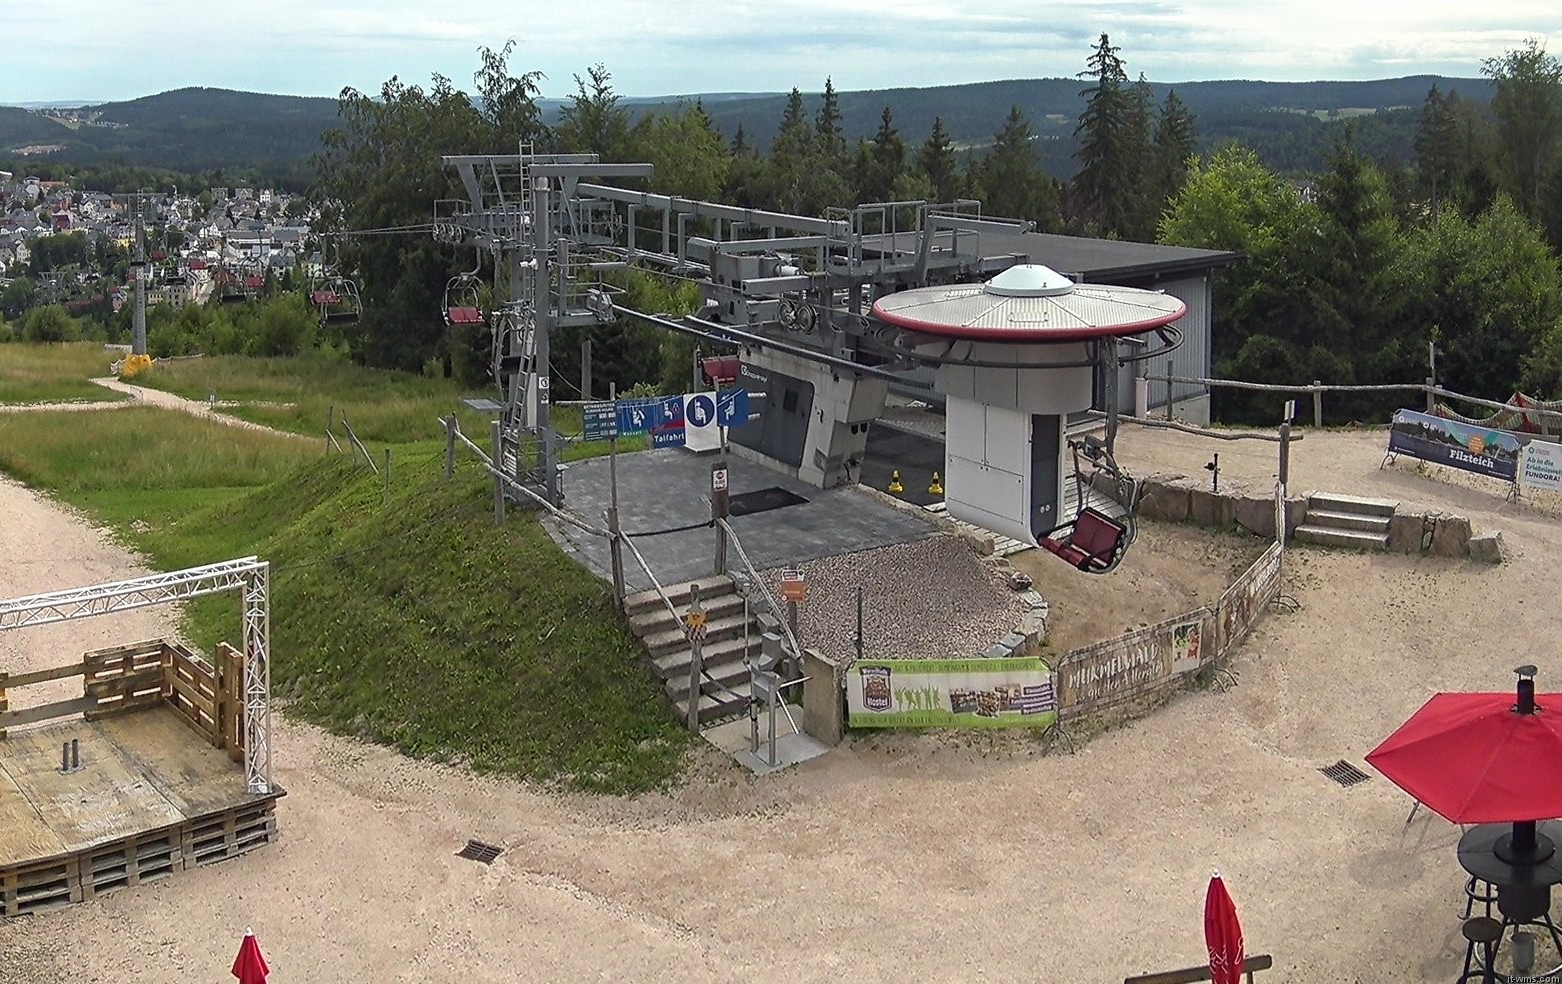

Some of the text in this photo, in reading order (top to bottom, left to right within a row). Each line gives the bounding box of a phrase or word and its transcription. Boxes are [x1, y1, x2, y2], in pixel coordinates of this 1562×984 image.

[654, 433, 685, 443] Talfahrt
[1449, 449, 1495, 469] Filzteich
[1068, 643, 1159, 689] MURMELWALD
